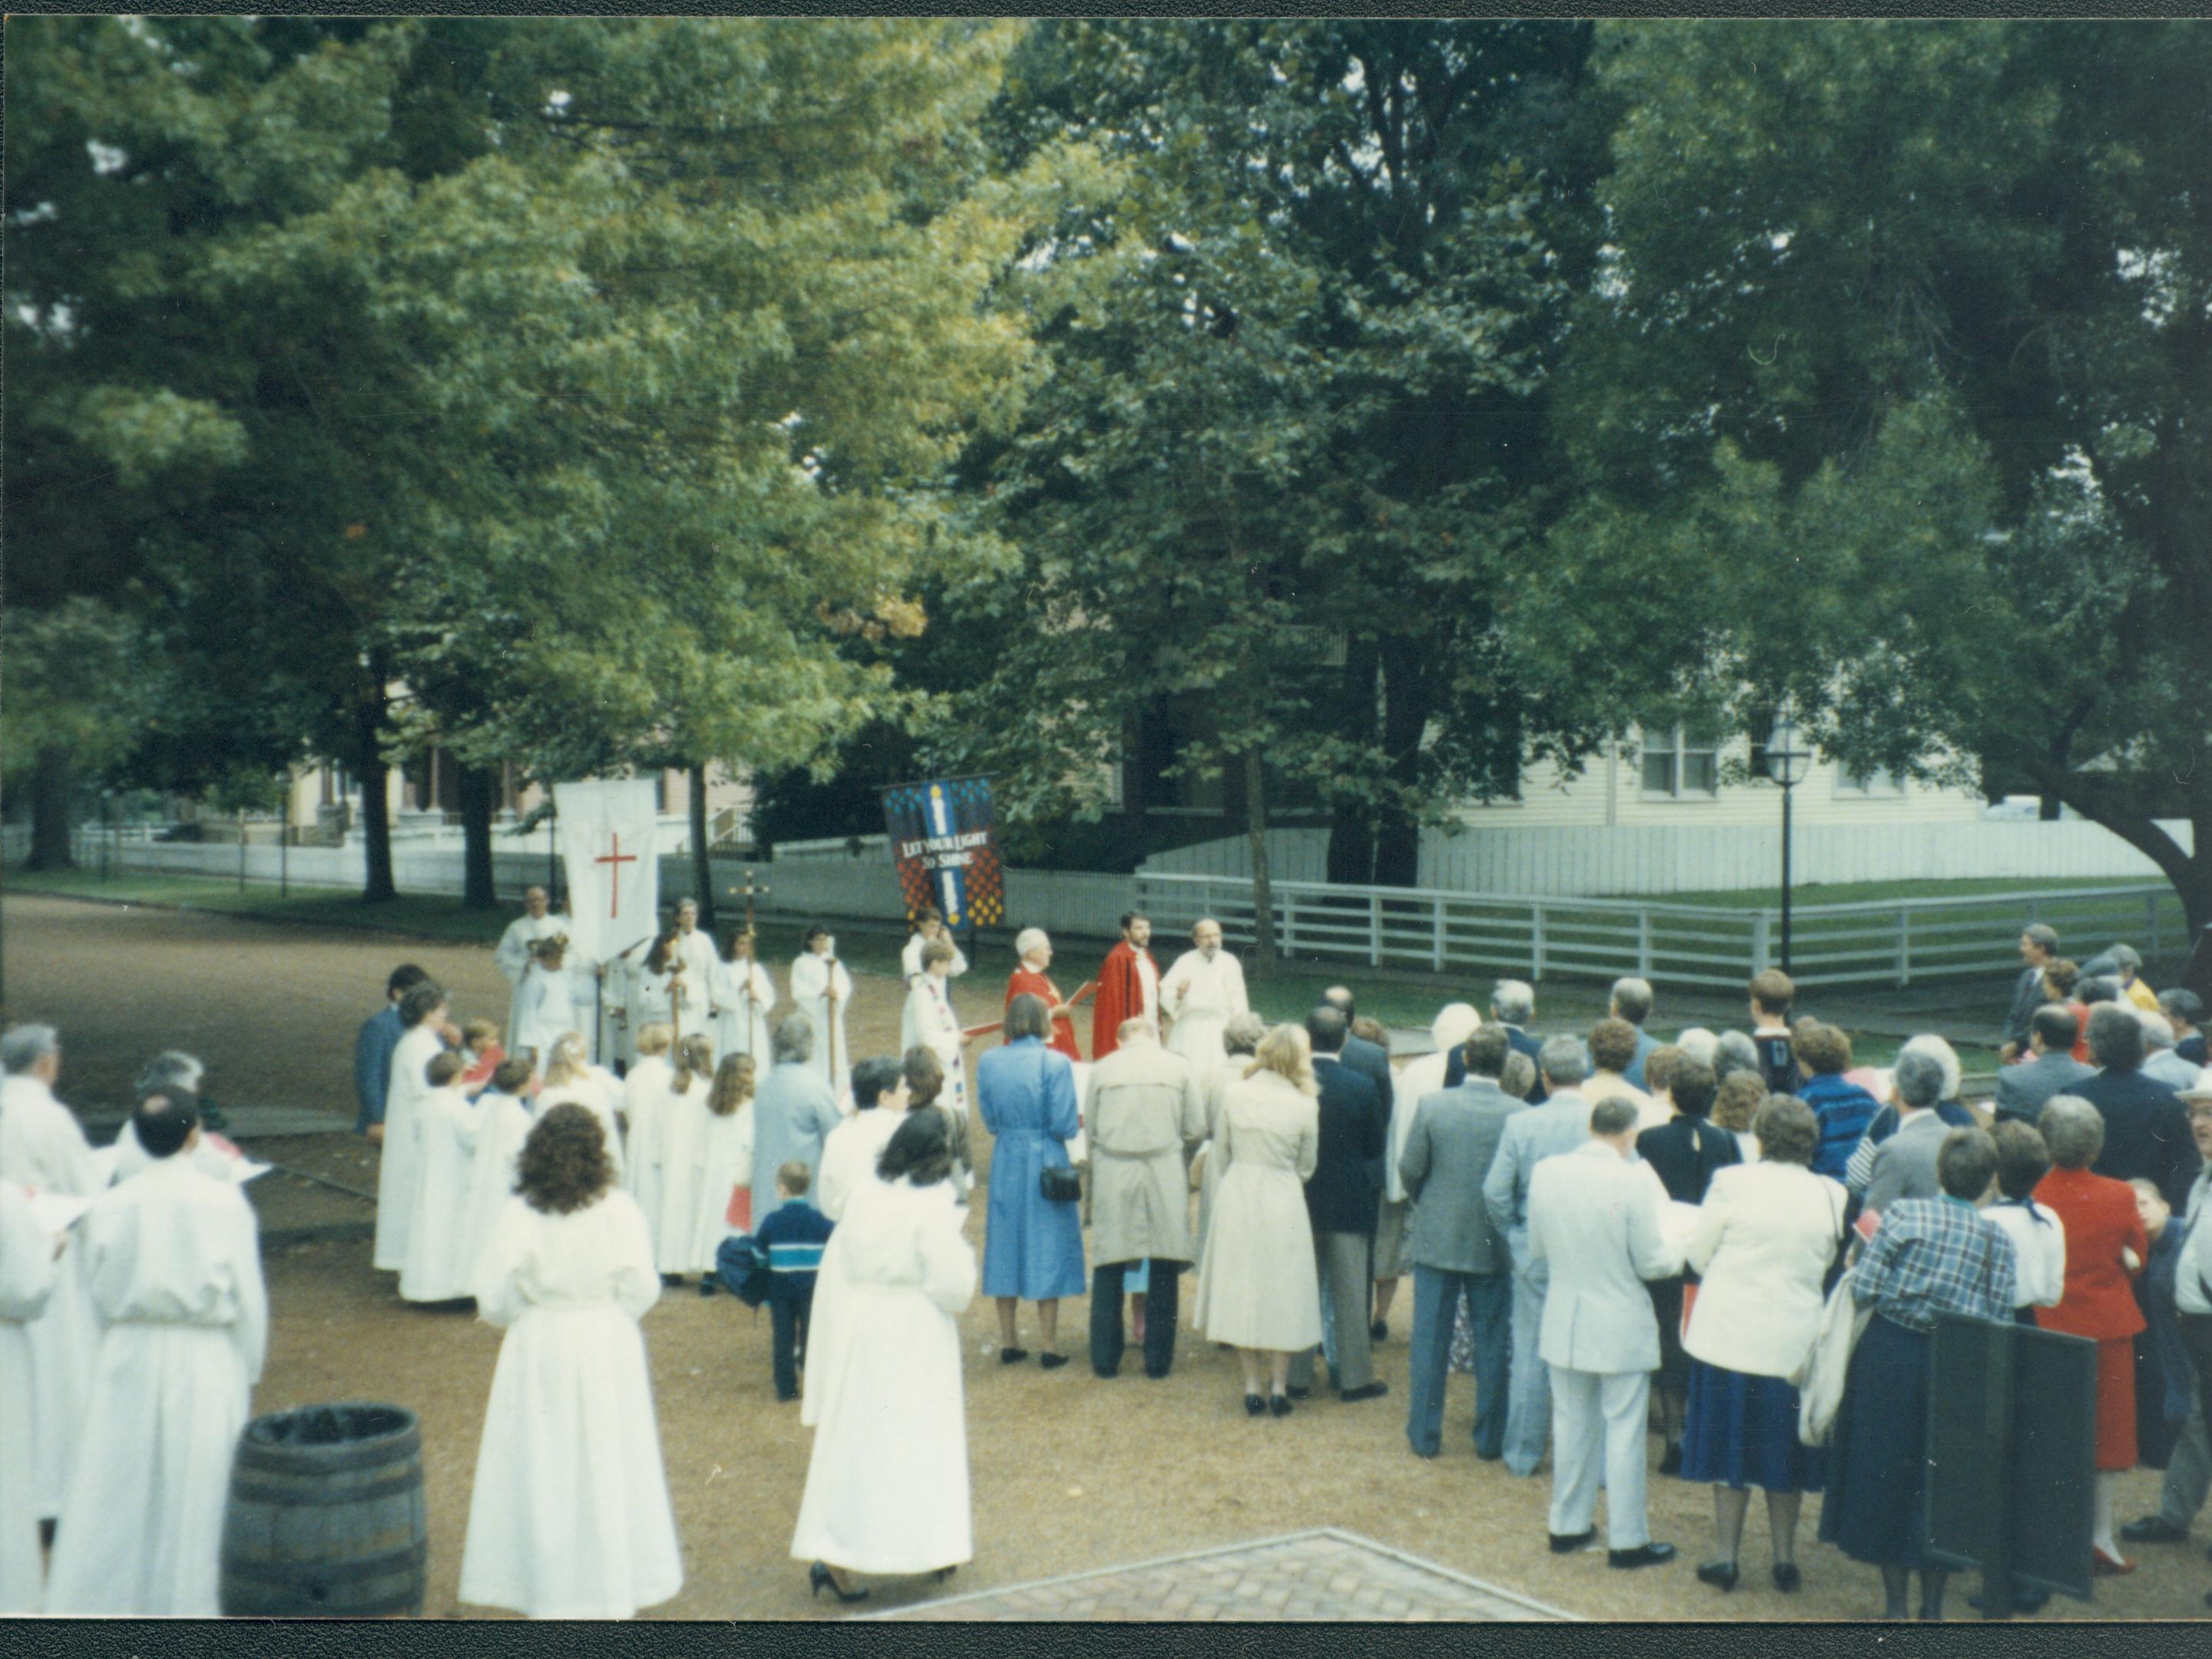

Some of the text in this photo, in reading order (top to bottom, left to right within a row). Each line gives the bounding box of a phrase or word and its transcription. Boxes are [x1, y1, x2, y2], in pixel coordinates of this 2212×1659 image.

[902, 831, 988, 858] LET YOUR LIGHT
[938, 851, 974, 868] SHINE
